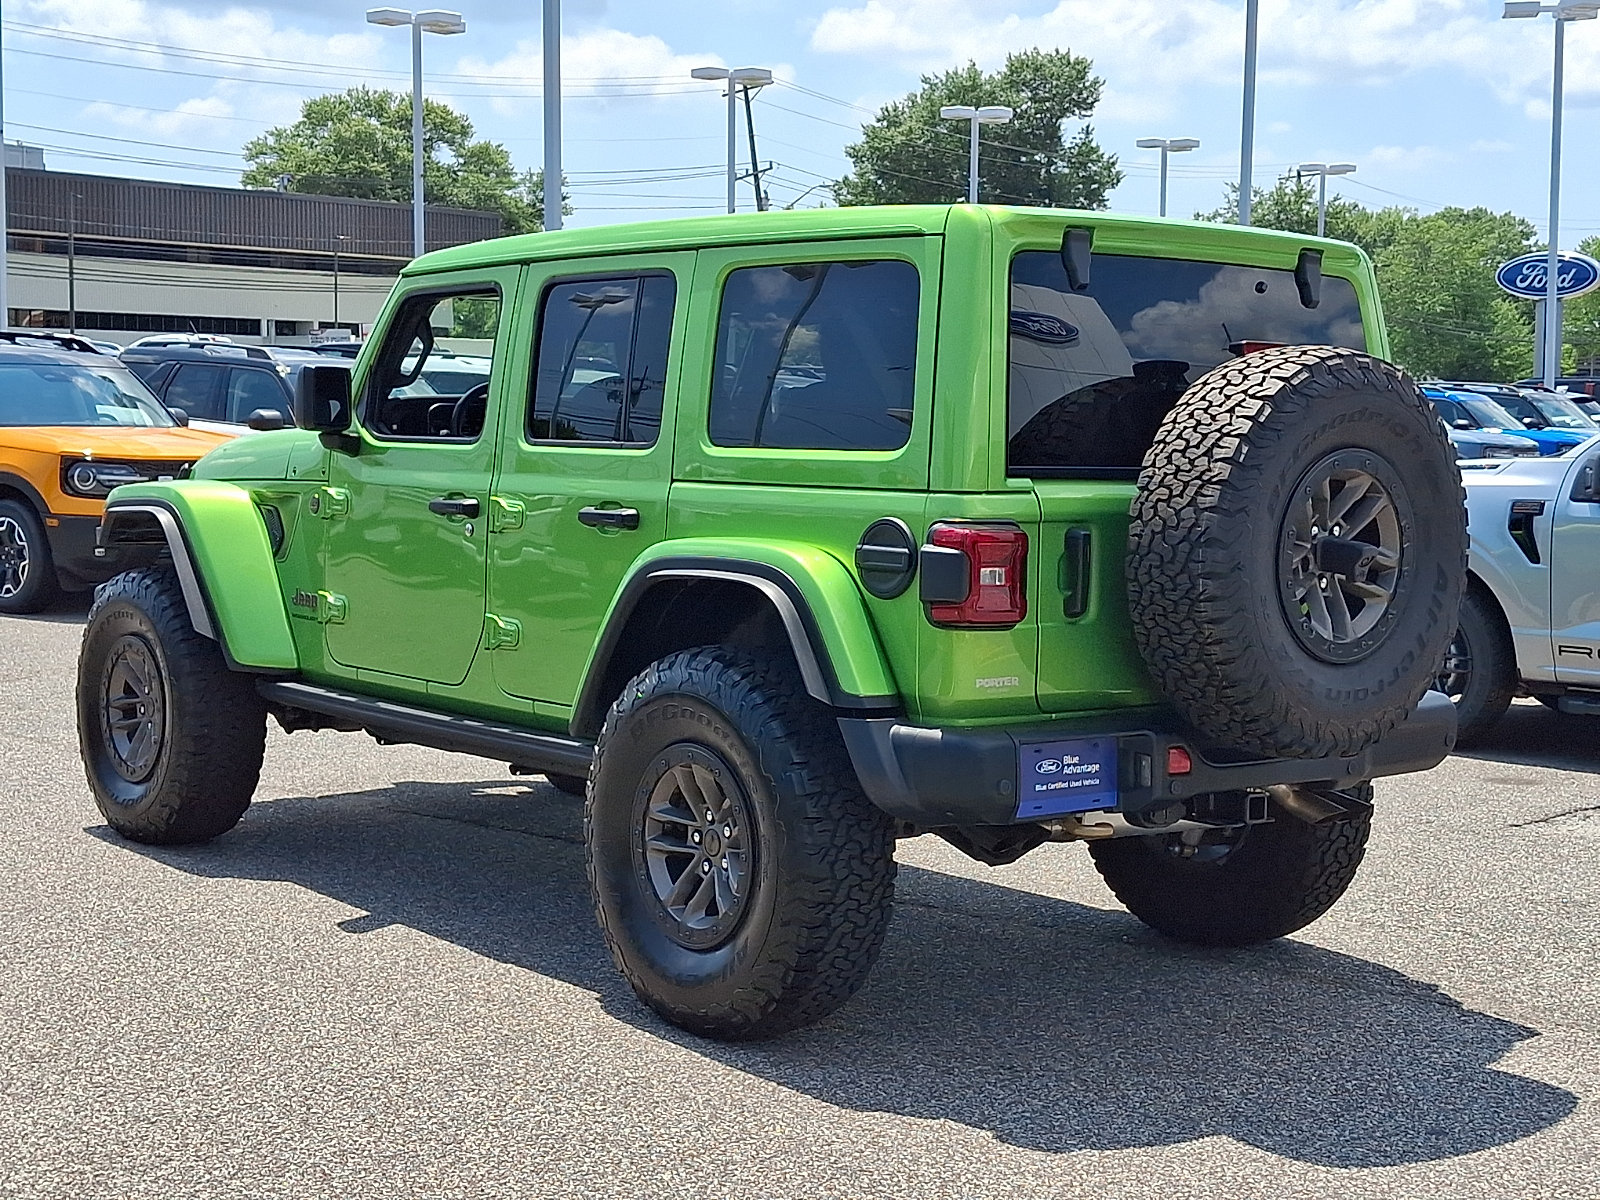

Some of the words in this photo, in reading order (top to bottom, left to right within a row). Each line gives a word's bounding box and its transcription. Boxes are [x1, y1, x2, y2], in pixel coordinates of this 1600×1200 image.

[1516, 262, 1577, 288] Fod
[1558, 644, 1600, 660] R
[976, 676, 1019, 688] PORTER
[1063, 754, 1080, 764] Blue
[1063, 763, 1100, 774] Advantage
[1047, 781, 1069, 790] Certified
[1083, 778, 1100, 786] Vehicle
